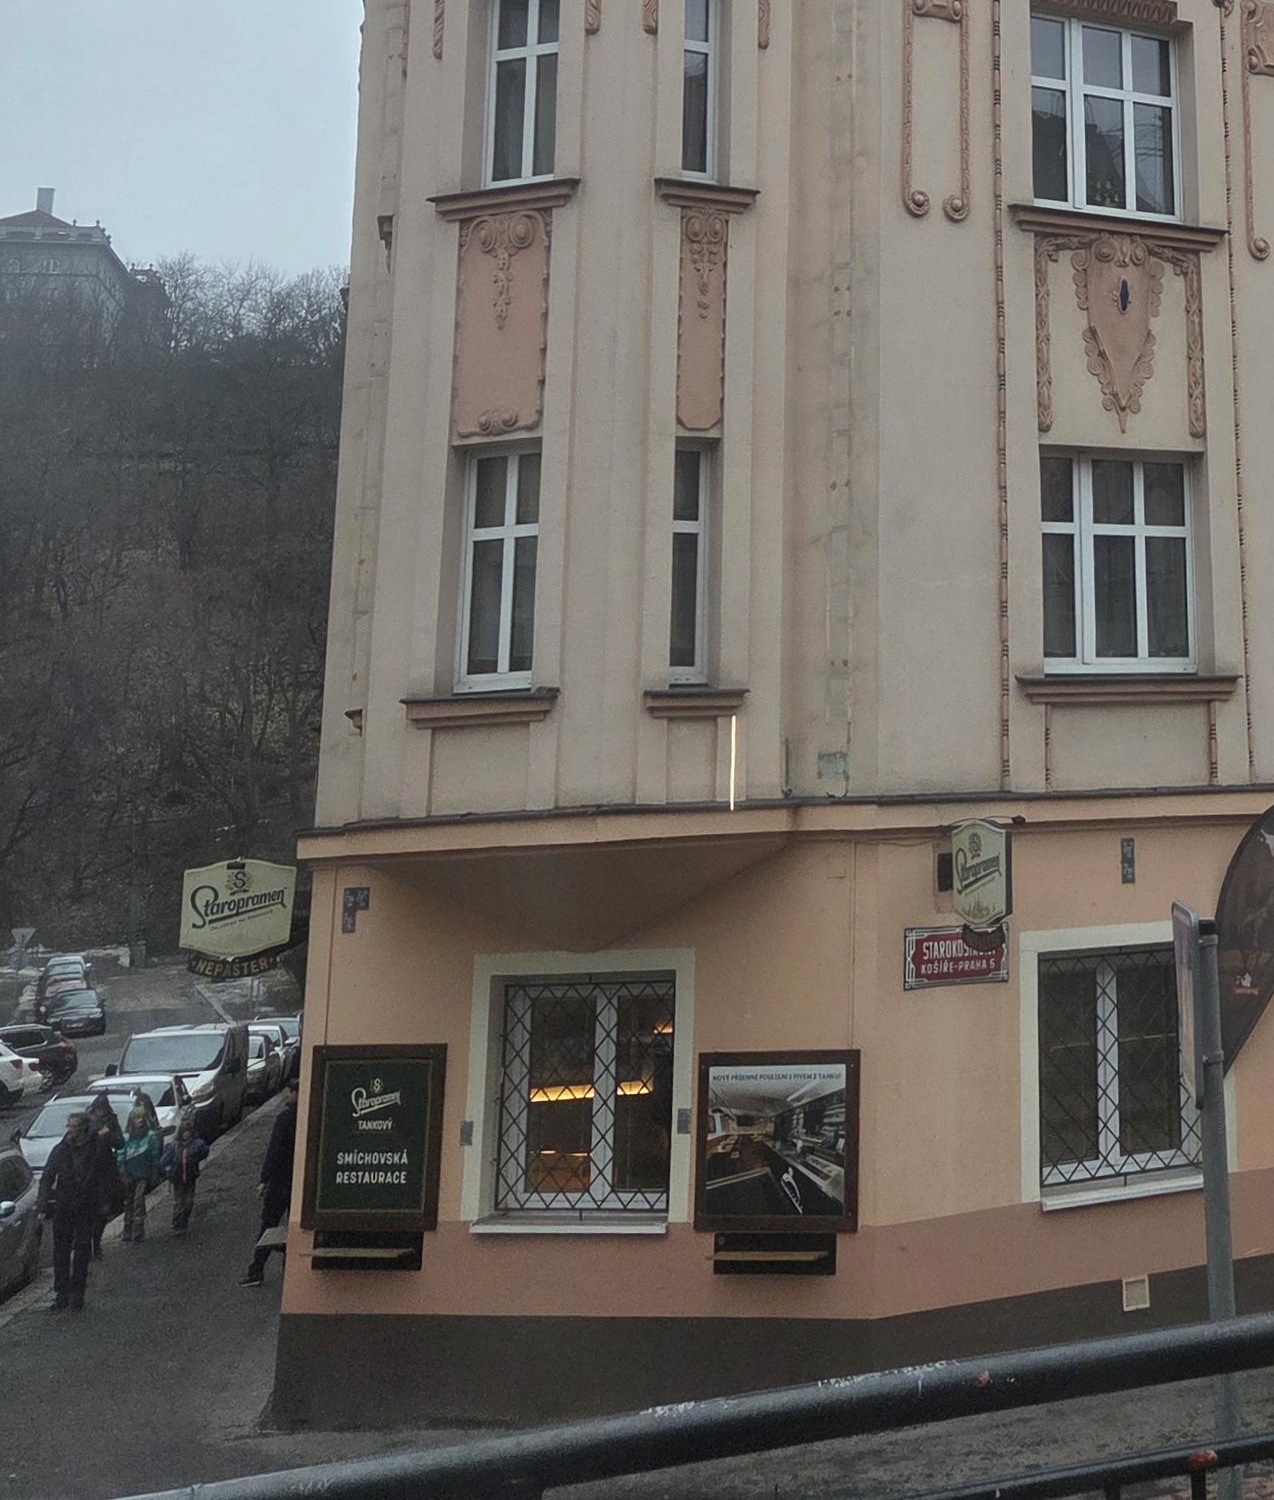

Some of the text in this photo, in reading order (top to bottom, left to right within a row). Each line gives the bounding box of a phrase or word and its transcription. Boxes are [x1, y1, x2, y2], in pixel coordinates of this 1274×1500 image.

[190, 885, 288, 929] Staropramen
[990, 958, 995, 969] 5
[358, 1117, 393, 1130] TANKOVÝ
[337, 1149, 408, 1165] SMÍCHOVSKÁ
[336, 1171, 407, 1184] RESTAURACE
